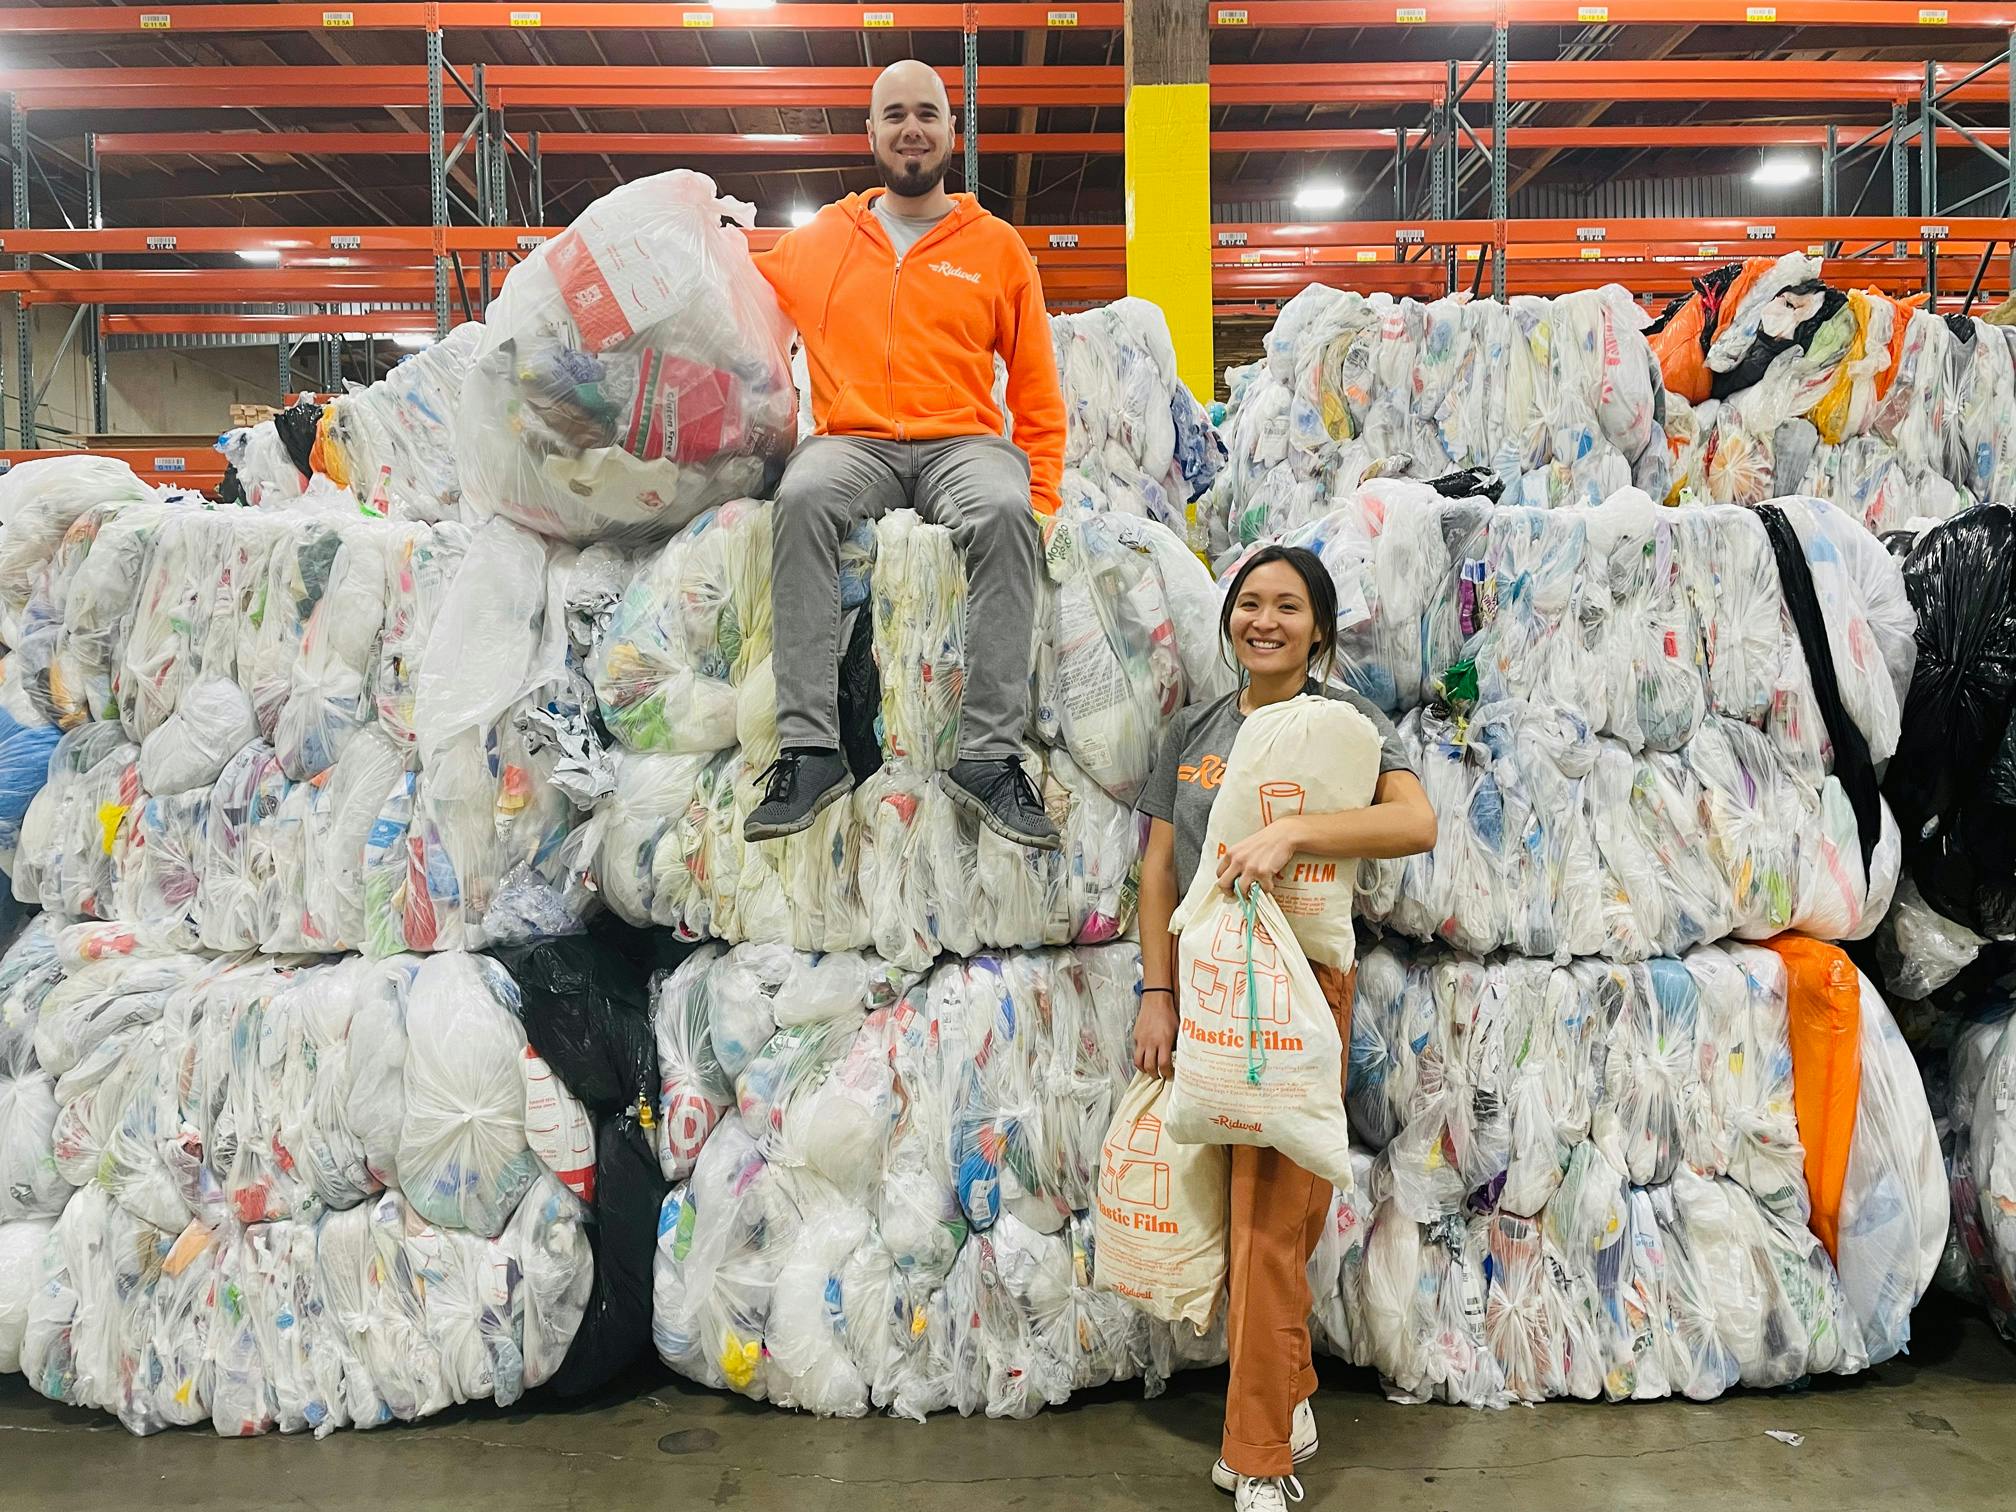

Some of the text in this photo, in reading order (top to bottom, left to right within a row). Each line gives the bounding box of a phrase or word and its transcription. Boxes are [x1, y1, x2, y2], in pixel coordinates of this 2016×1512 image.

[938, 261, 981, 283] Ridwell
[666, 391, 675, 452] Gluten Free
[1293, 863, 1336, 882] FILM
[1182, 1018, 1303, 1051] Plastic Film
[1218, 1115, 1263, 1132] Ridwell
[1133, 1212, 1179, 1234] Film
[1119, 1282, 1153, 1300] Ridwell
